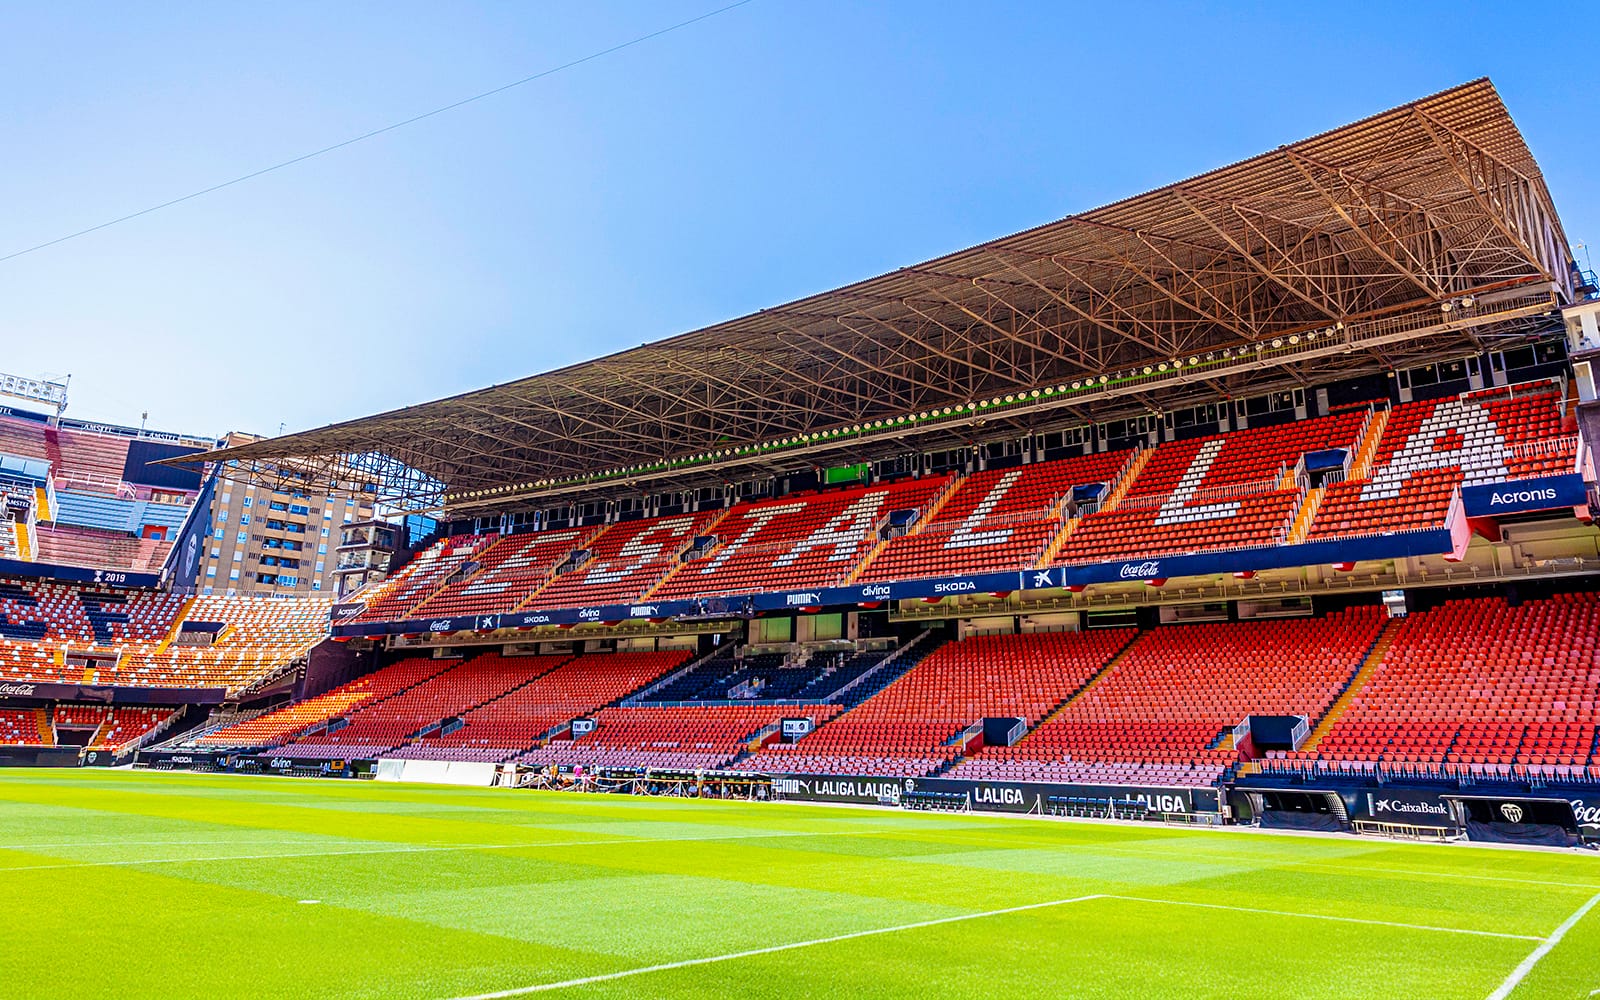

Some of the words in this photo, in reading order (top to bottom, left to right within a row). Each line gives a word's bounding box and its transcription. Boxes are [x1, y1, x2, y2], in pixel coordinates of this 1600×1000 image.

[84, 423, 113, 434] AMSTEL
[149, 432, 179, 441] AMSTEL
[1489, 488, 1557, 506] Acronis
[7, 499, 30, 508] AMSTEL
[104, 572, 126, 583] 2019
[862, 584, 891, 596] divina
[786, 593, 811, 606] PUMA
[578, 606, 600, 618] divina
[630, 606, 651, 617] PUMA
[270, 757, 292, 768] divina
[771, 778, 800, 794] PUMA
[815, 780, 856, 796] LALIGA
[857, 782, 900, 799] LALIGA
[974, 787, 1024, 804] LALIGA
[1391, 800, 1448, 815] CaixaBank
